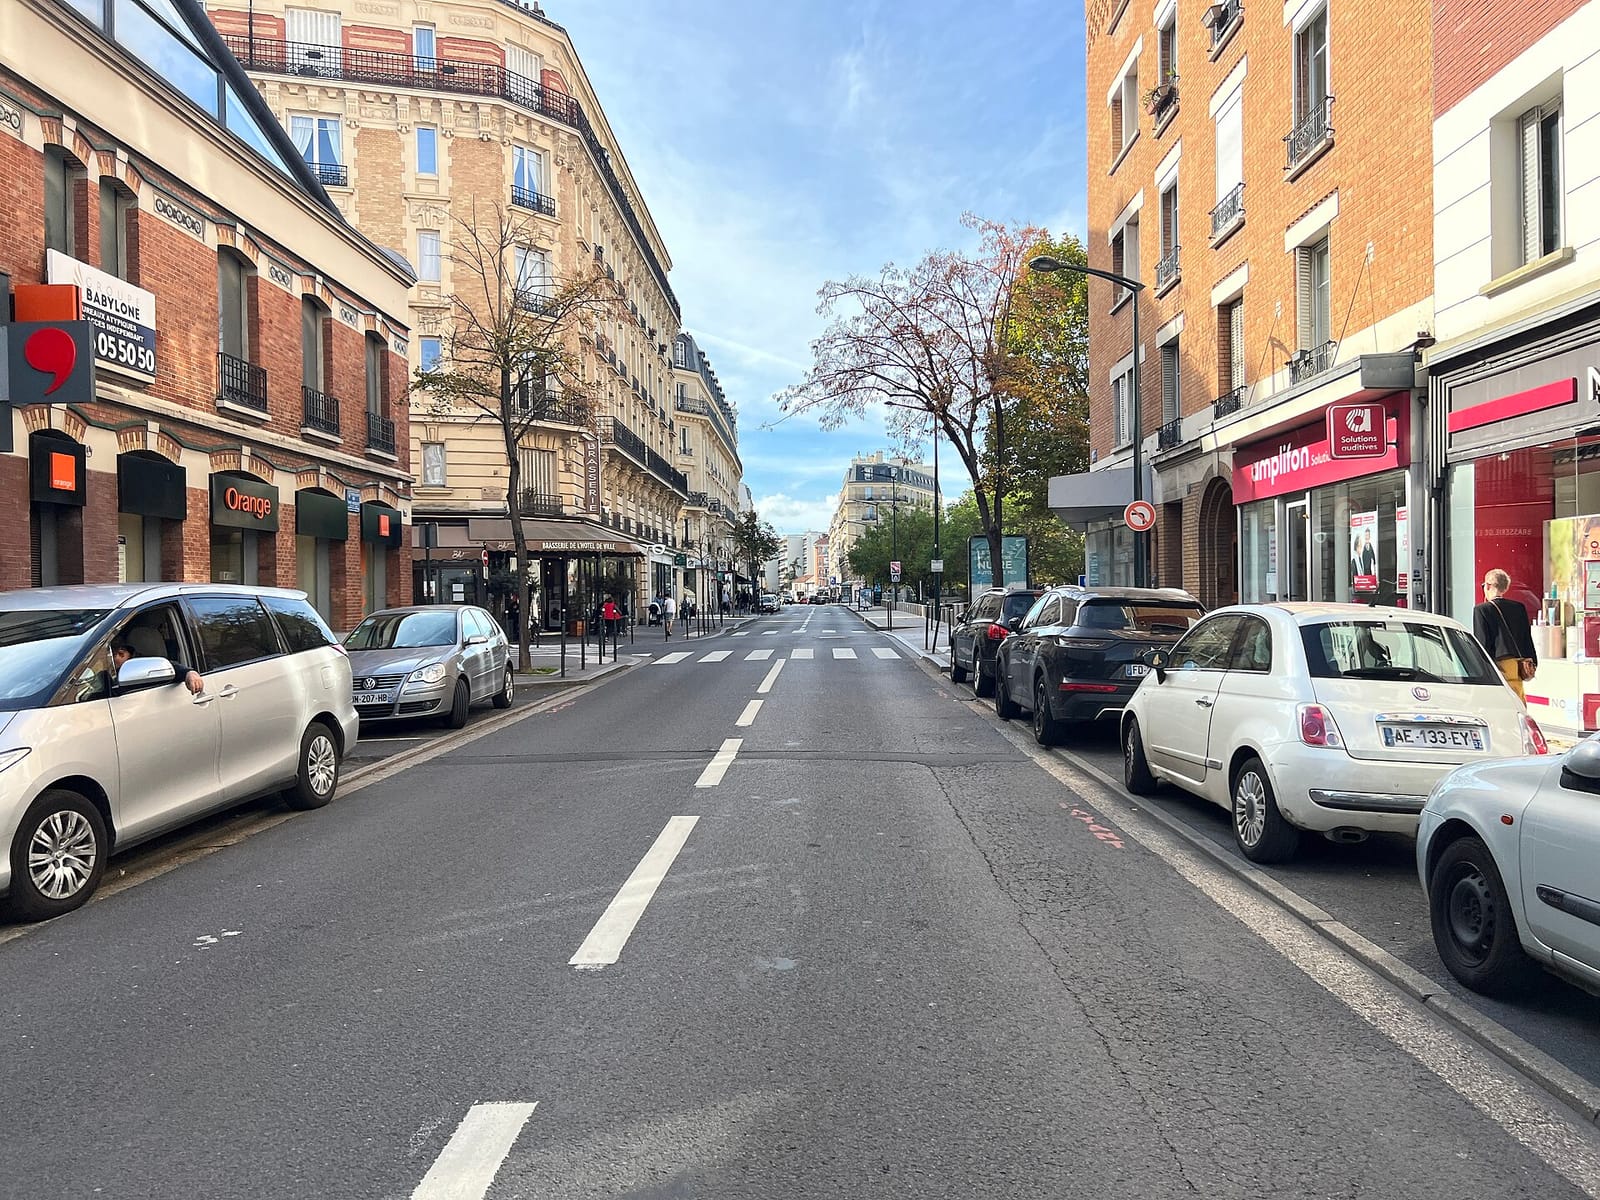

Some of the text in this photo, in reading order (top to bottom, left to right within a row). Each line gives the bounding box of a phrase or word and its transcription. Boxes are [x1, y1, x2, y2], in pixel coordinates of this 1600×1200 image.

[86, 277, 140, 307] GROUPE
[86, 288, 140, 320] BABYLONE
[82, 306, 137, 332] UREAUX ATYPIQUES
[106, 324, 145, 343] INDEPENDANT
[98, 332, 155, 372] 05 50 50
[1341, 435, 1378, 444] Solutions
[1341, 443, 1378, 452] auditives
[586, 442, 598, 512] BRASSERIE
[1251, 442, 1309, 485] amplifon
[225, 487, 271, 519] Orange
[1394, 729, 1469, 746] AE-133-EY
